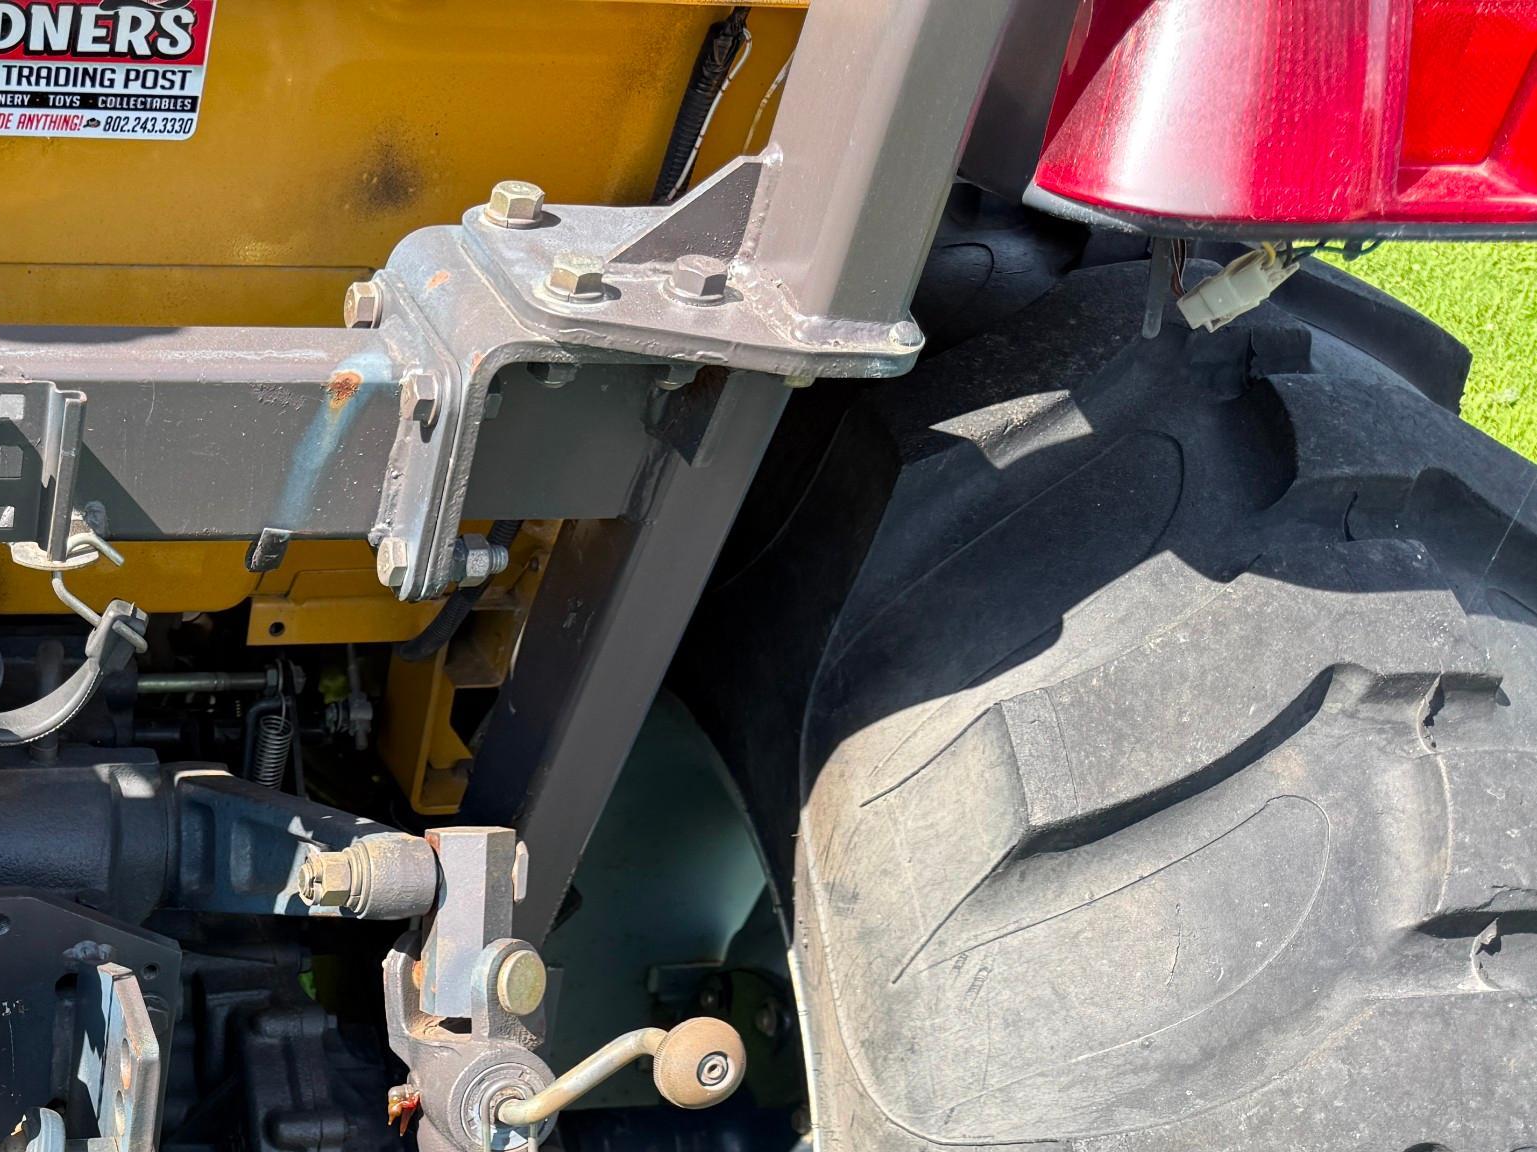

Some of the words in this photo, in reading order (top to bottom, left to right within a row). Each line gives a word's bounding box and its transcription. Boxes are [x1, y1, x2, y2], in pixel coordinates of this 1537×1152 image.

[3, 65, 116, 89] TRADING
[124, 69, 193, 91] POST
[48, 94, 81, 107] TOYS
[97, 96, 192, 110] COLLECTABLES
[16, 113, 85, 132] ANYTHING!
[103, 116, 194, 135] 802.243.3330
